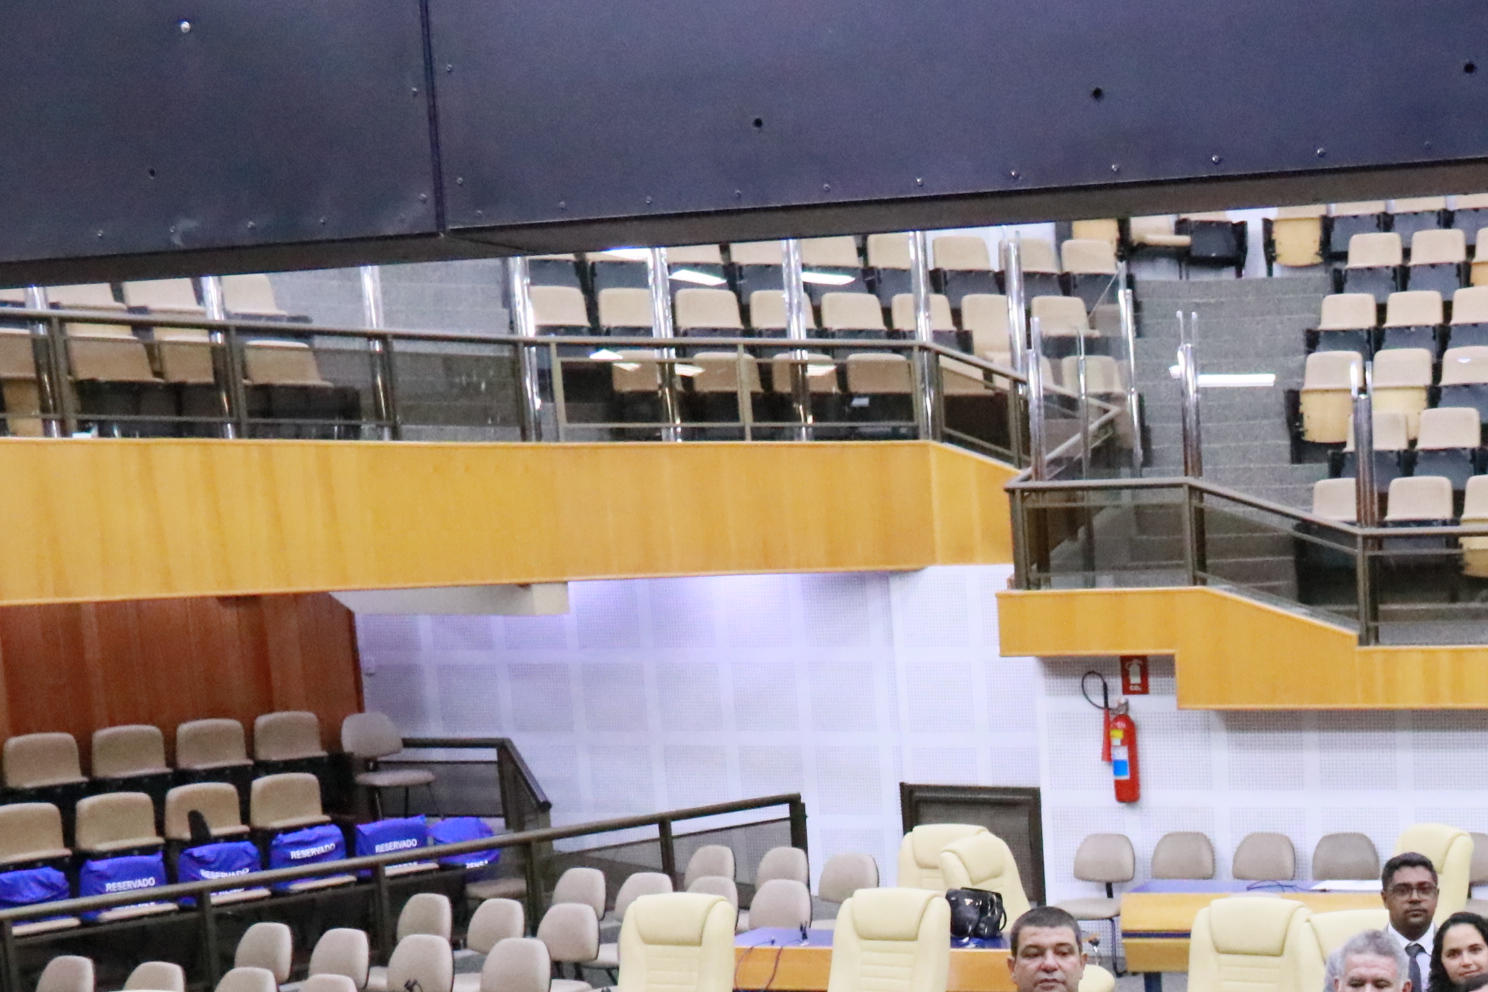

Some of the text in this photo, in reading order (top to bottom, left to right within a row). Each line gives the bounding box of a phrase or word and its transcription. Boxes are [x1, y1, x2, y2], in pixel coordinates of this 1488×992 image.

[290, 843, 336, 859] RESERVADO
[375, 839, 417, 853] RESERVADO
[105, 877, 155, 892] RESERVADO
